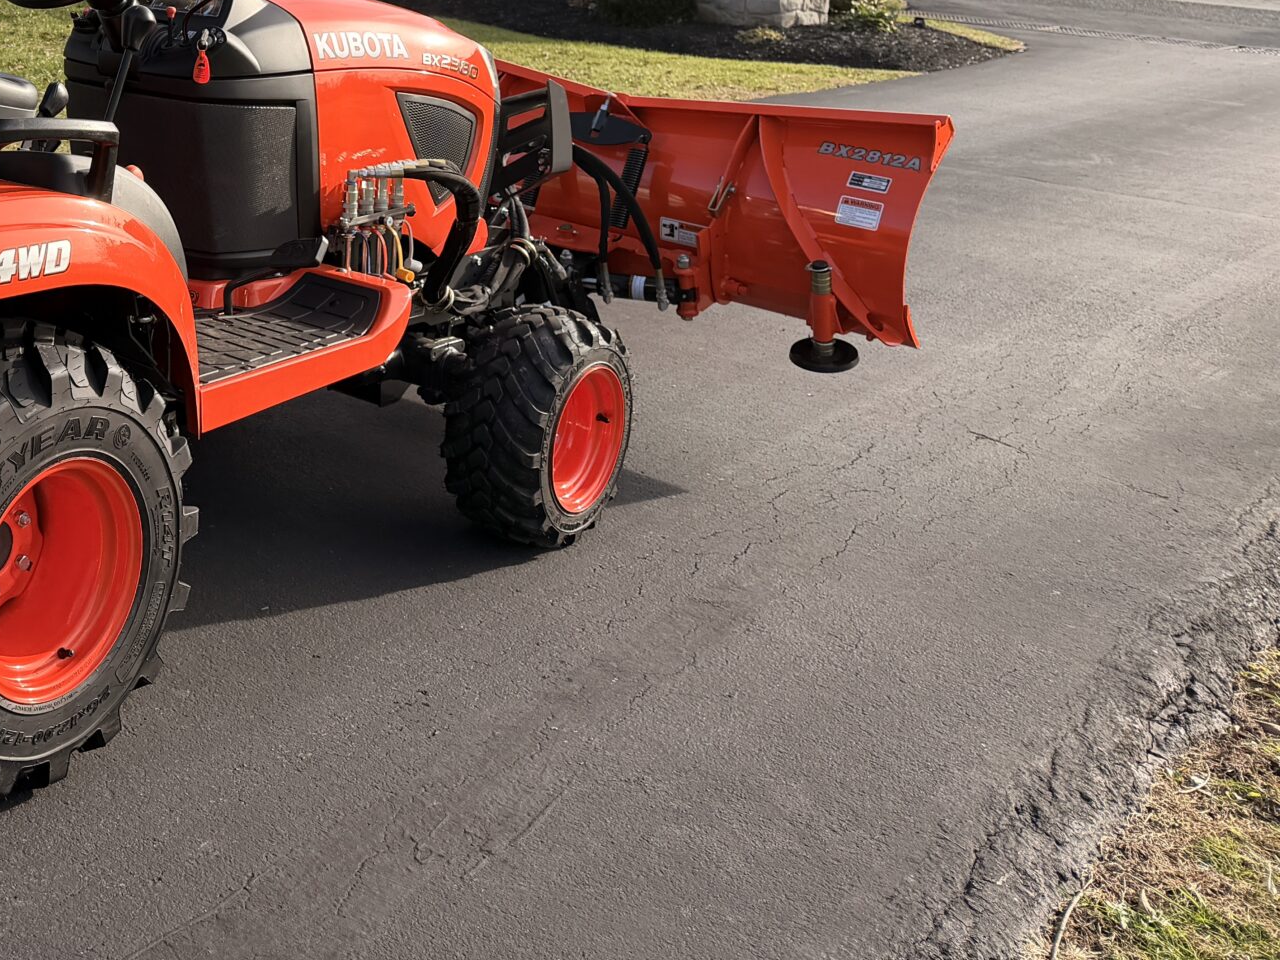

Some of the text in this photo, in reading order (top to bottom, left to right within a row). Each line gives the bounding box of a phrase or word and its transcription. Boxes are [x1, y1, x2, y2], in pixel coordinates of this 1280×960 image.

[313, 31, 409, 60] KUBOTA
[421, 53, 479, 80] BX2380
[817, 141, 921, 171] BX2812A
